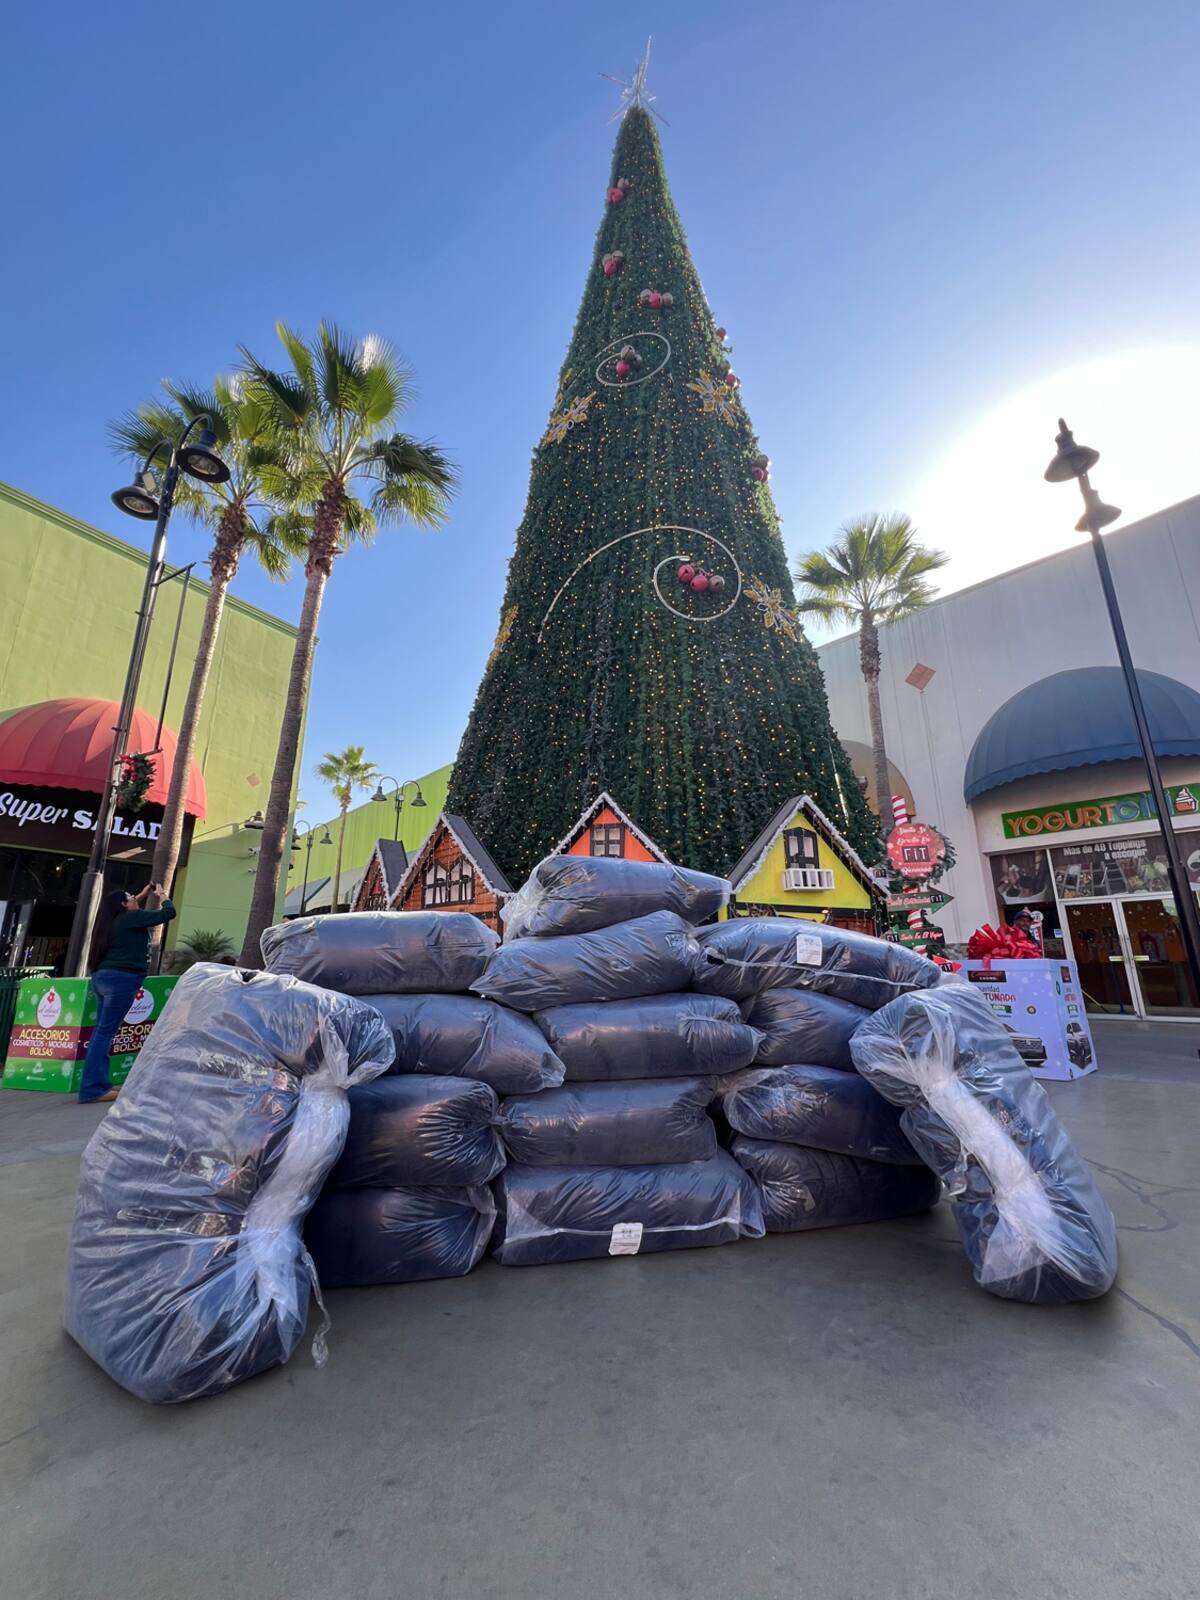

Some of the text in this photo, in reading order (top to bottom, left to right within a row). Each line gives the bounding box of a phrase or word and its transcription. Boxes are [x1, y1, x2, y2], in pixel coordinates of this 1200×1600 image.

[0, 792, 161, 840] Super SLAD
[1108, 839, 1147, 851] Toppings
[1111, 848, 1148, 859] escoger
[983, 993, 1016, 1003] TUNADA
[19, 1029, 71, 1041] ACCESORIOS
[29, 1048, 53, 1056] BOLSAS
